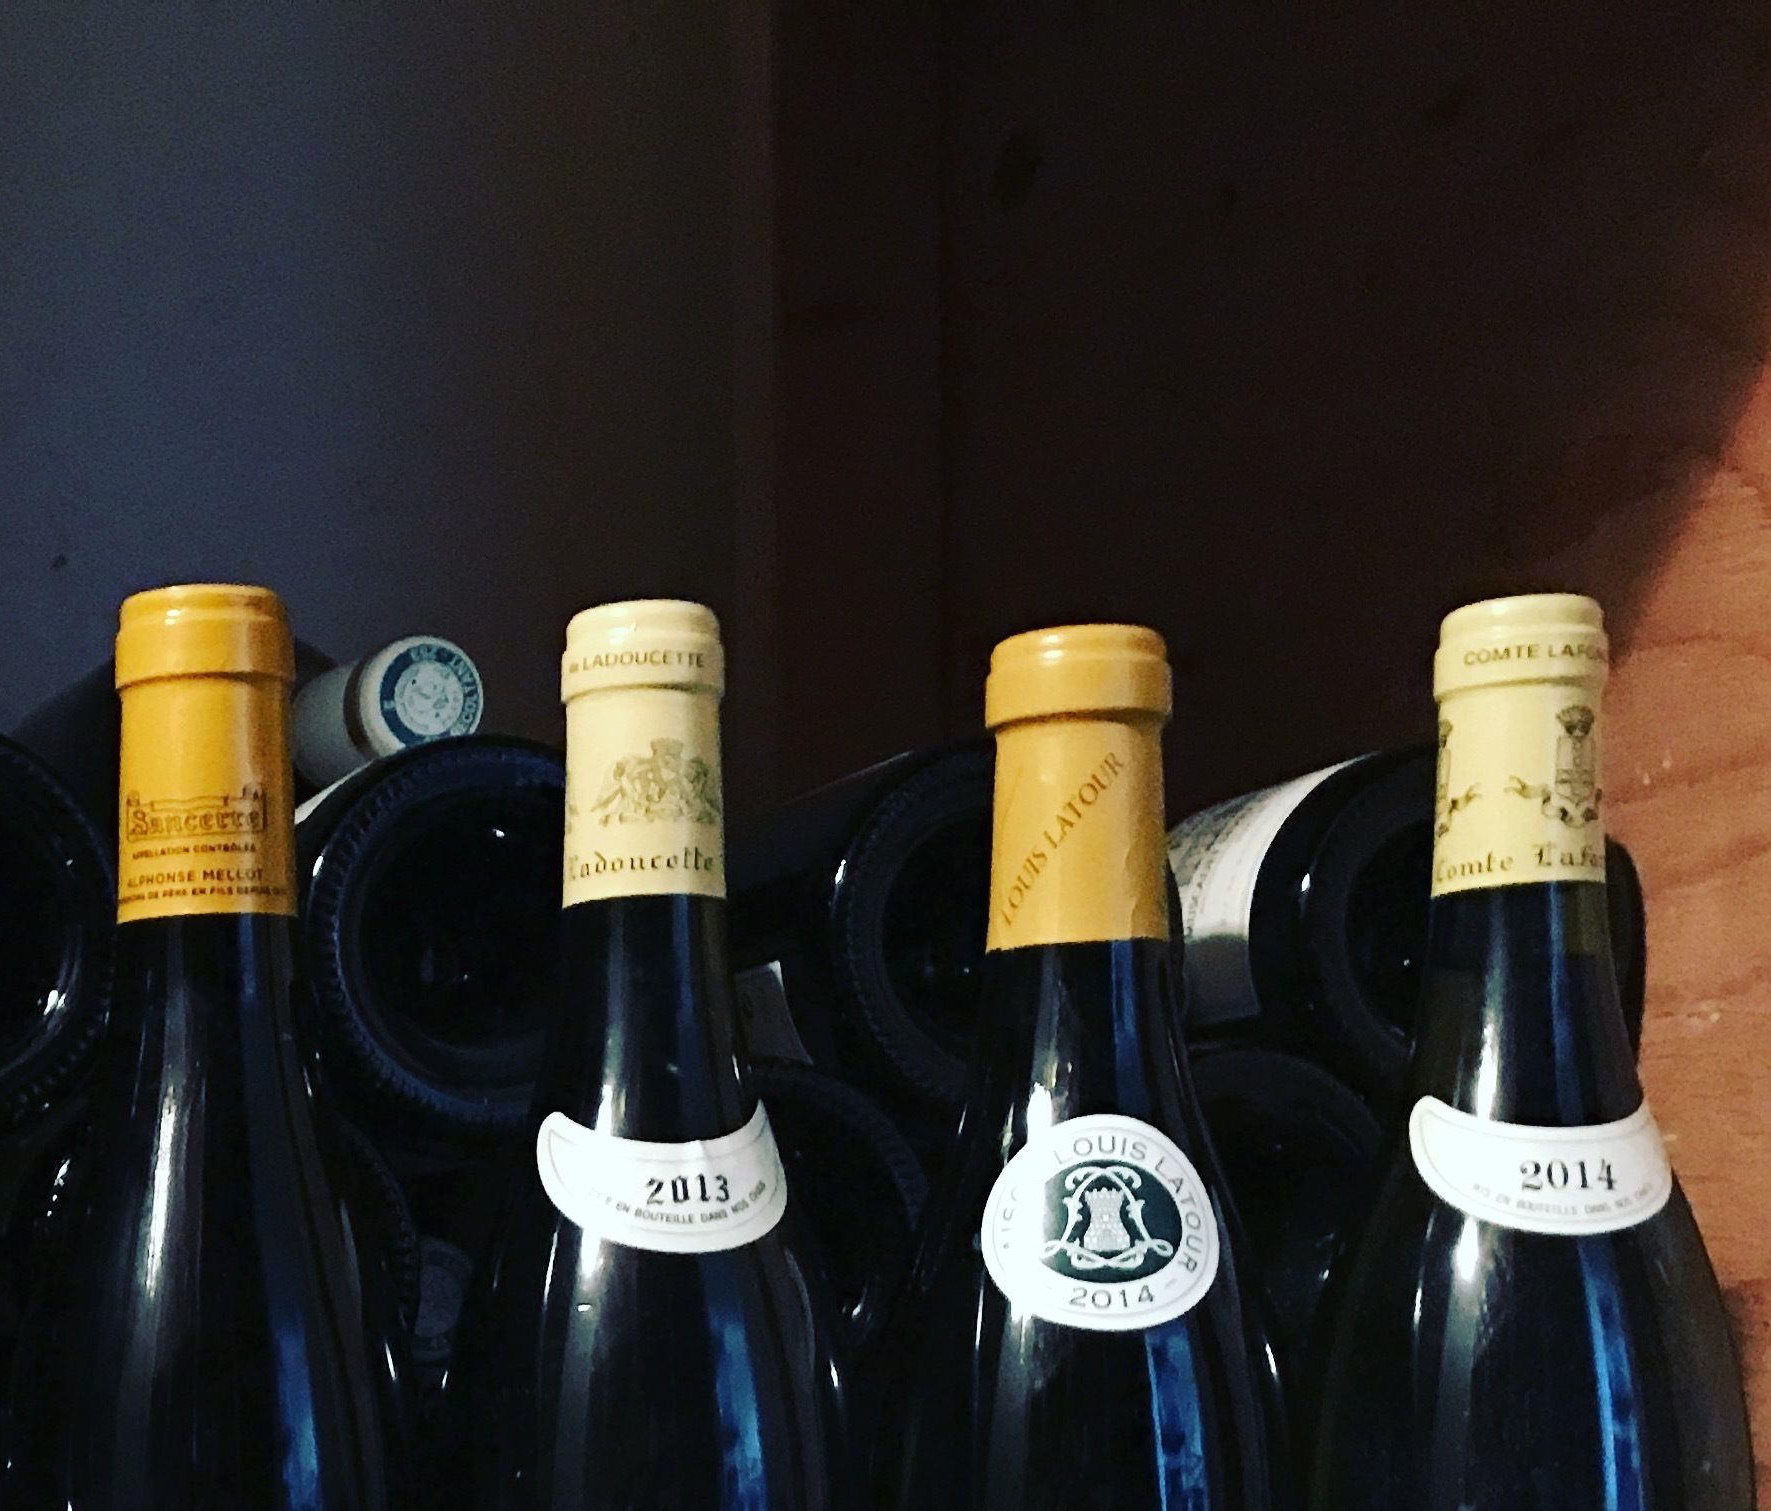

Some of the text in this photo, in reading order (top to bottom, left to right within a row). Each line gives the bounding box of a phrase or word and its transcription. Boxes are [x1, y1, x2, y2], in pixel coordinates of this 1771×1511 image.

[582, 650, 705, 671] LADOUCETTE
[1463, 643, 1538, 665] COMTE
[1043, 752, 1125, 850] LATOUR
[132, 808, 261, 836] Sancerre
[203, 867, 263, 882] MELLOT
[1520, 1158, 1618, 1191] 2014
[645, 1172, 731, 1206] 2013
[634, 1208, 694, 1224] BOUTEILLE
[1053, 1135, 1204, 1274] LOUIS LATOUR
[1068, 1284, 1155, 1310] 2014
